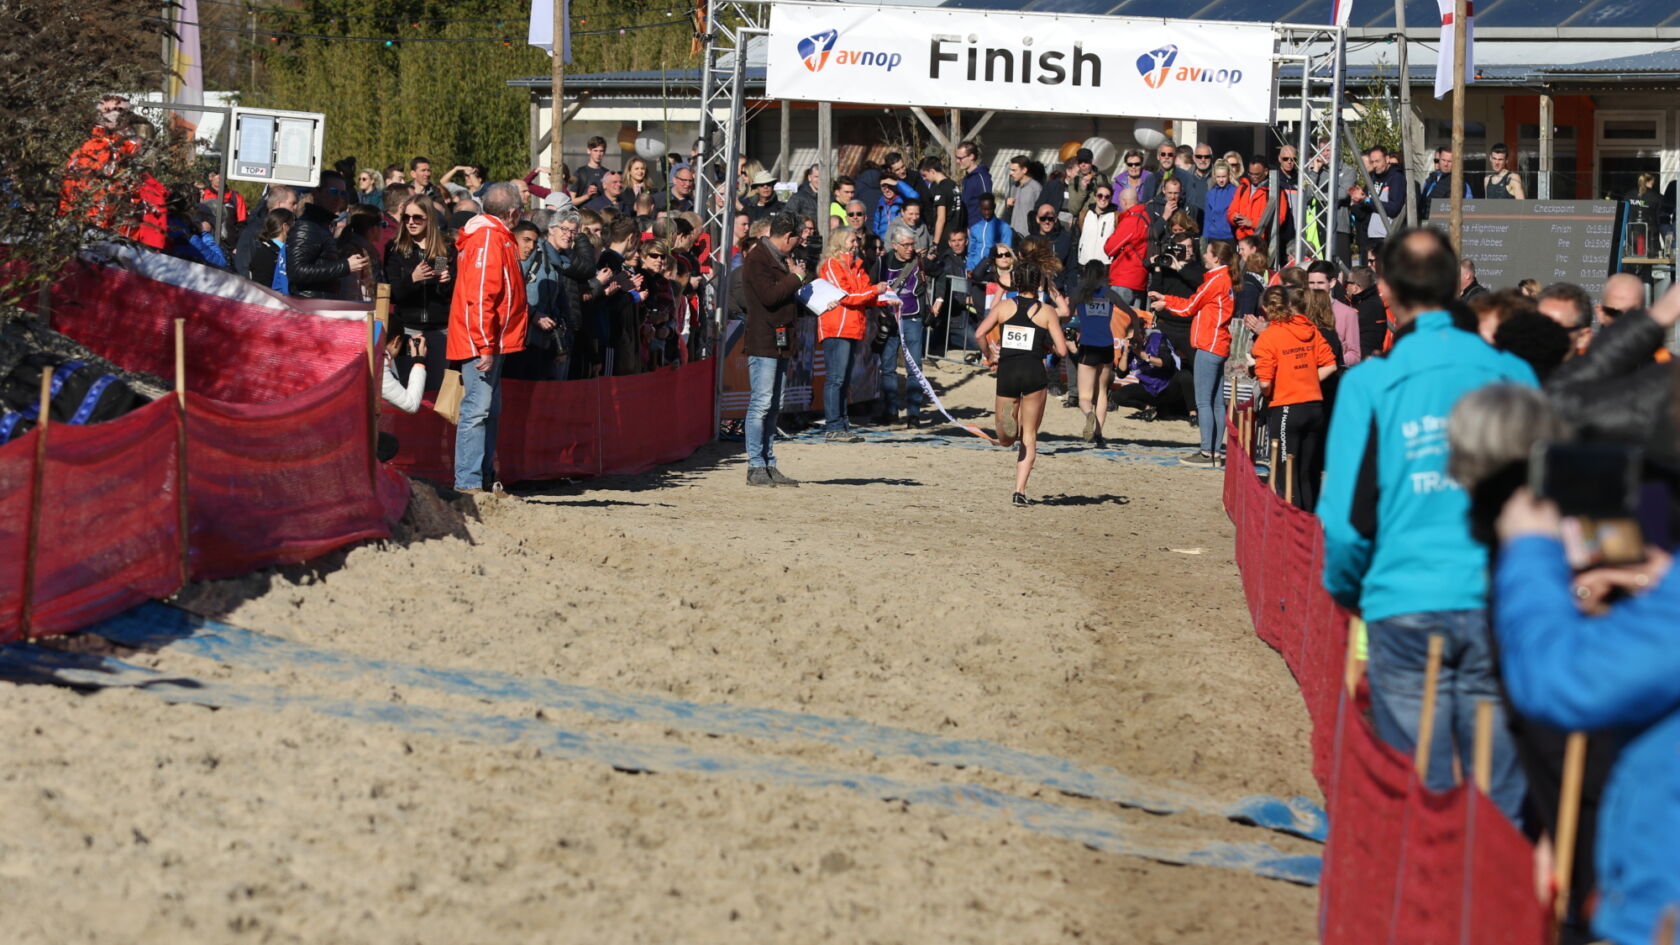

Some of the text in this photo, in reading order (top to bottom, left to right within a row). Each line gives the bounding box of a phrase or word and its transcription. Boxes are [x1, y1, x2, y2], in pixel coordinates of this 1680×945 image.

[836, 49, 902, 71] avnop
[930, 33, 1102, 87] Finish
[1175, 65, 1242, 88] avnop
[1534, 204, 1575, 213] Checkpoint
[1007, 331, 1028, 342] 561
